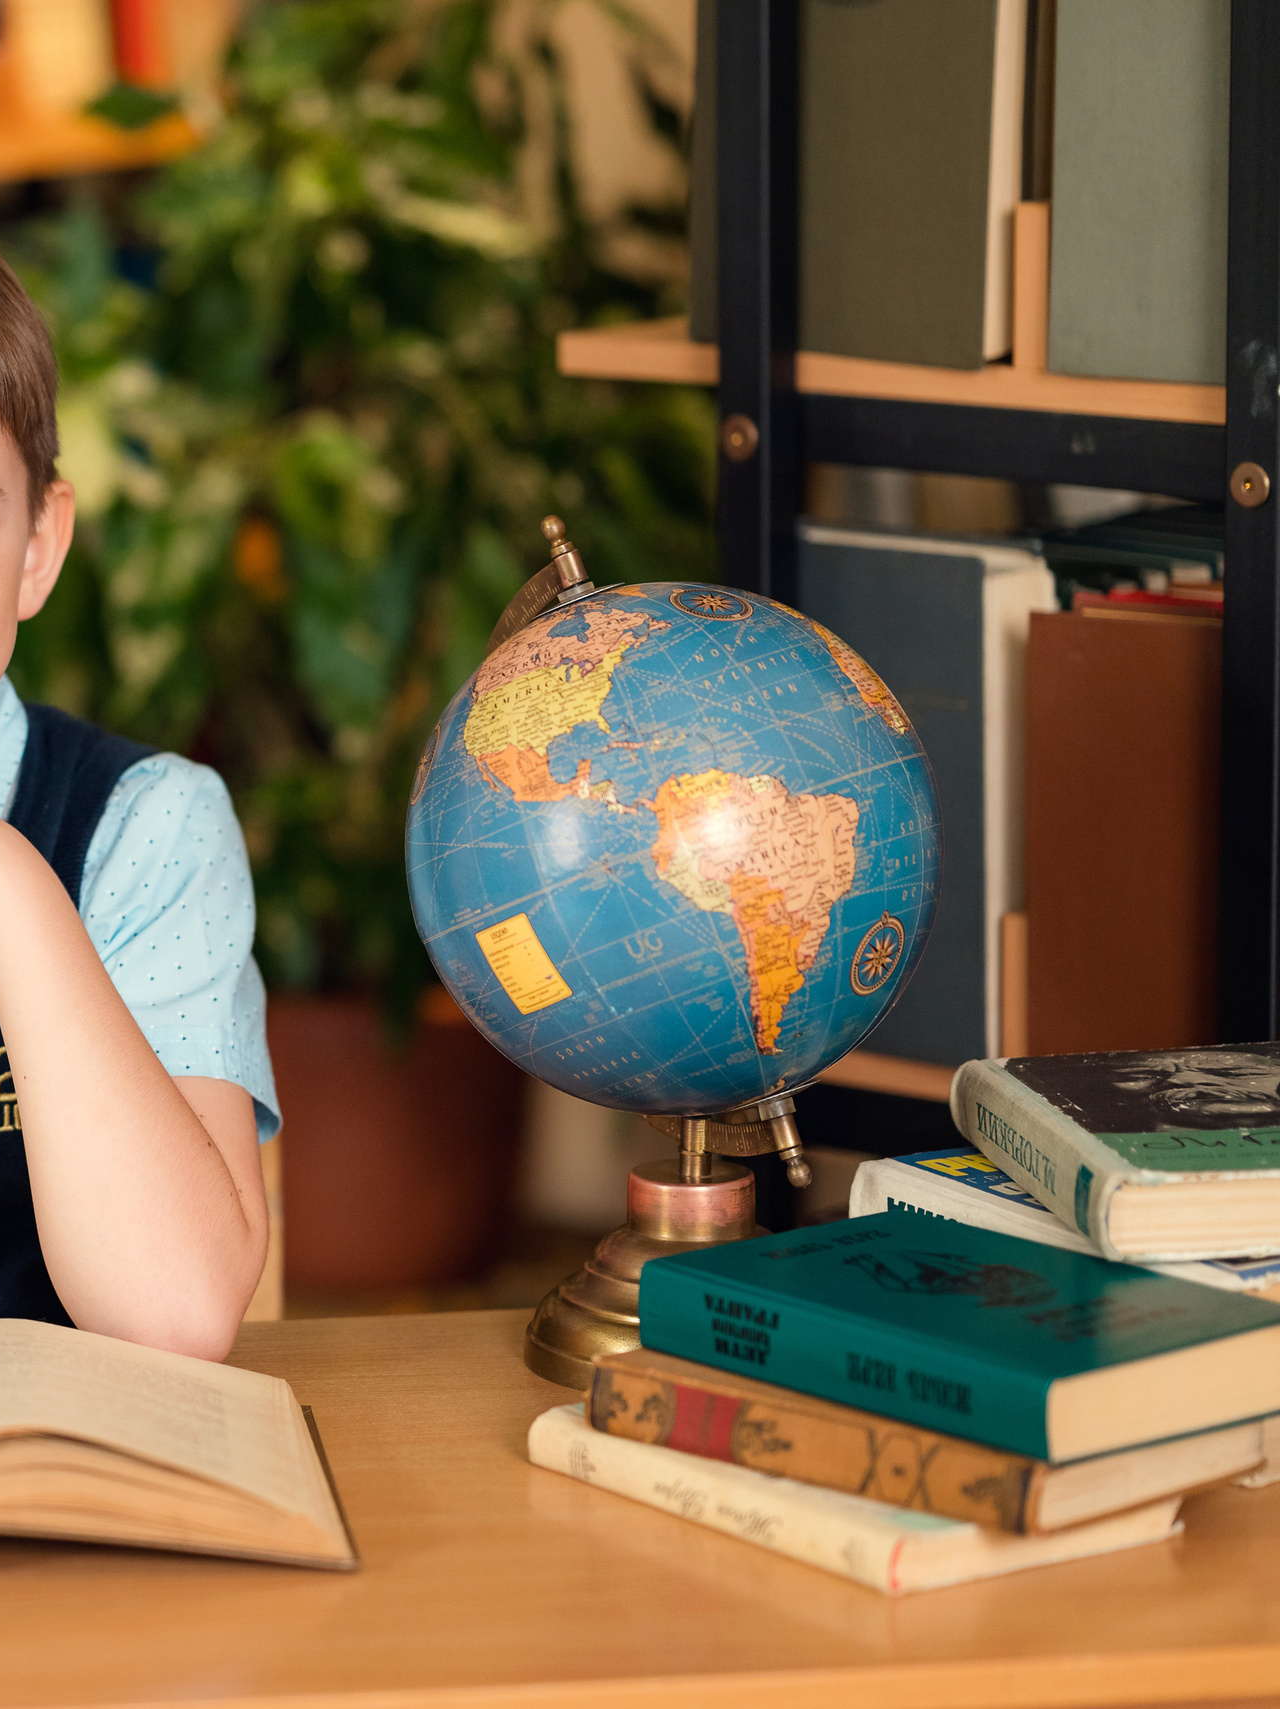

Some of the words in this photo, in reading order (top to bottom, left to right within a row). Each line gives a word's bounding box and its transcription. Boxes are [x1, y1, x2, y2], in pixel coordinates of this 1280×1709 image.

[692, 635, 757, 663] NORTH
[703, 651, 800, 690] ATLANTIC
[731, 683, 798, 714] OCEAN
[556, 1035, 606, 1060] SOUTH
[573, 1051, 641, 1080] PACIFIC
